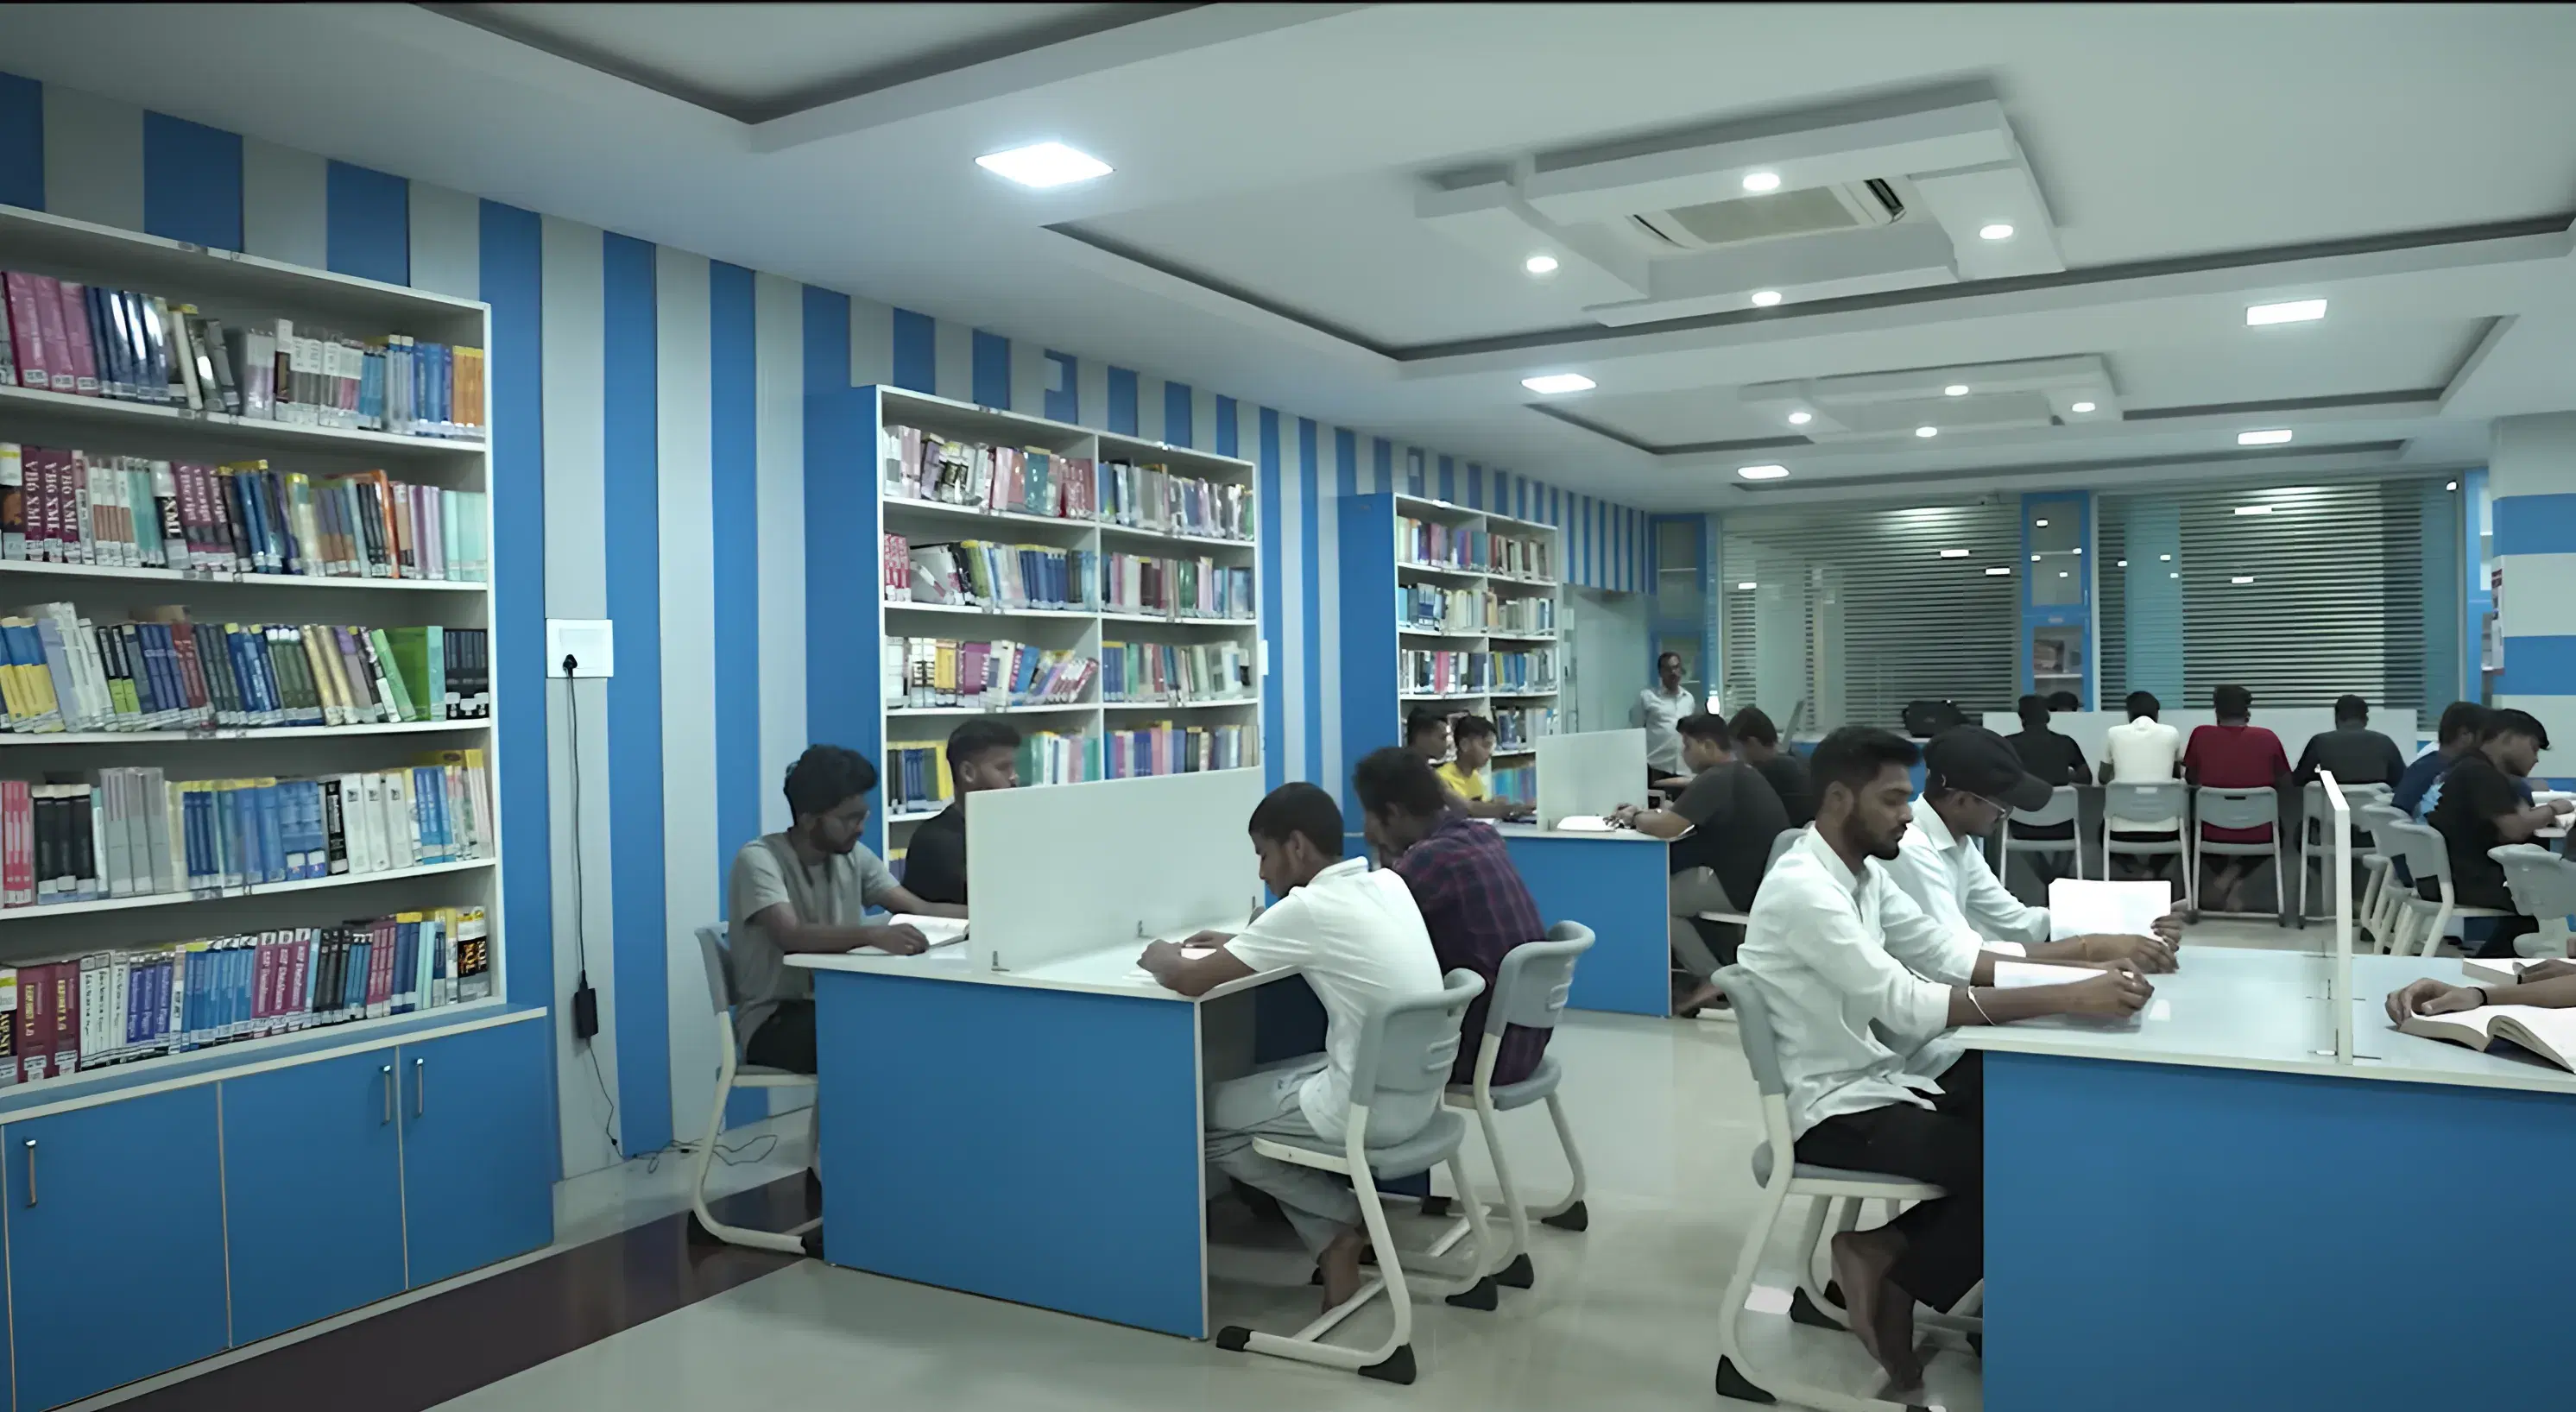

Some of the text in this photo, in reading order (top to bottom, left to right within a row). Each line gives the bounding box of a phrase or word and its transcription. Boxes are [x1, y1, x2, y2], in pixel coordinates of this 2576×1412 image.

[25, 461, 41, 531] VB6 XML
[45, 463, 60, 533] VB6 XML
[61, 464, 77, 533] VB6 XML
